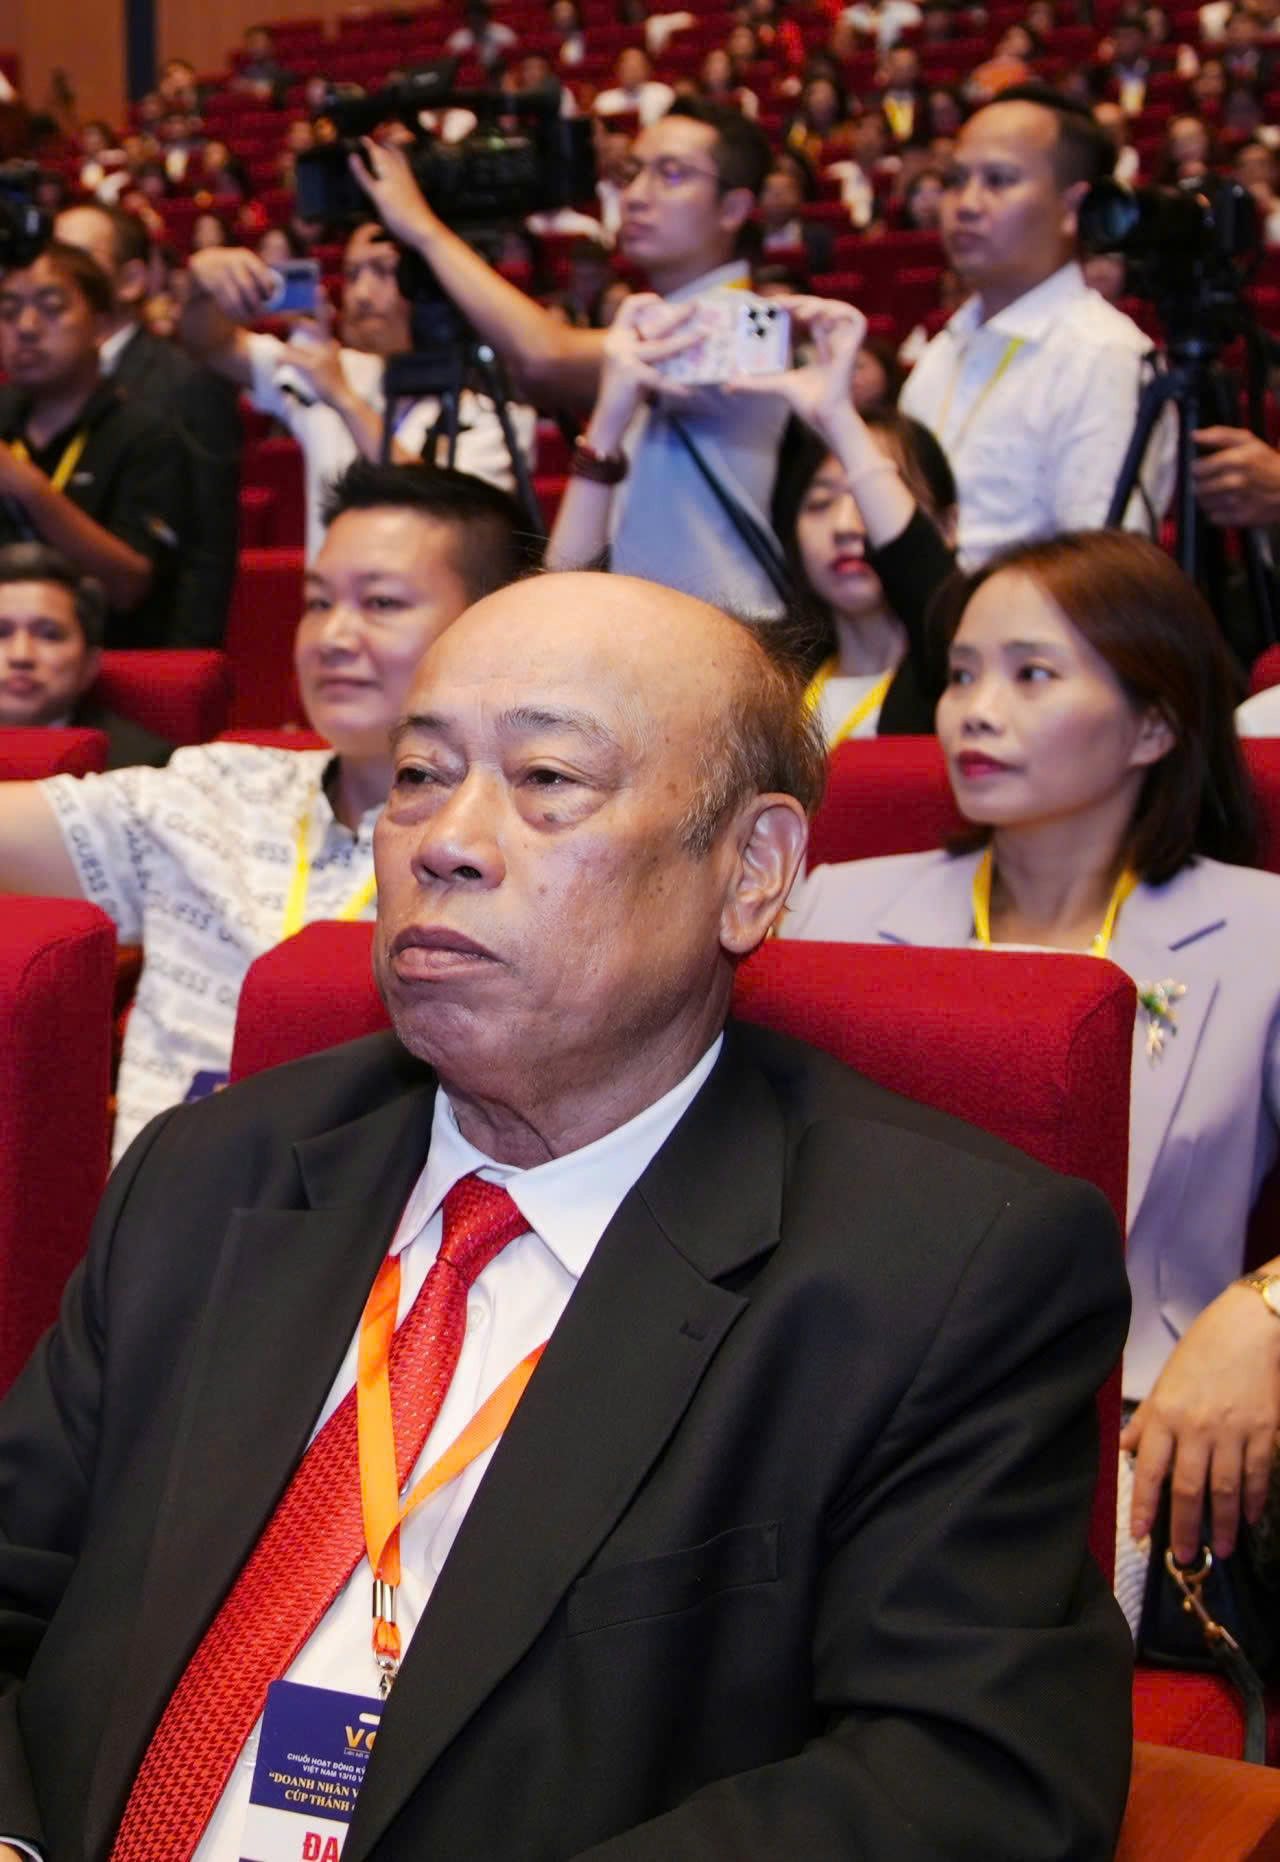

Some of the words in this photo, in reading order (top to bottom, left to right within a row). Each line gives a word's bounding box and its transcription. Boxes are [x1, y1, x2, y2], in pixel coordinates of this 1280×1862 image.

[320, 1768, 337, 1778] NAM
[317, 1781, 350, 1797] NHÂN
[285, 1788, 308, 1803] CÚP
[310, 1794, 350, 1812] THÁNH
